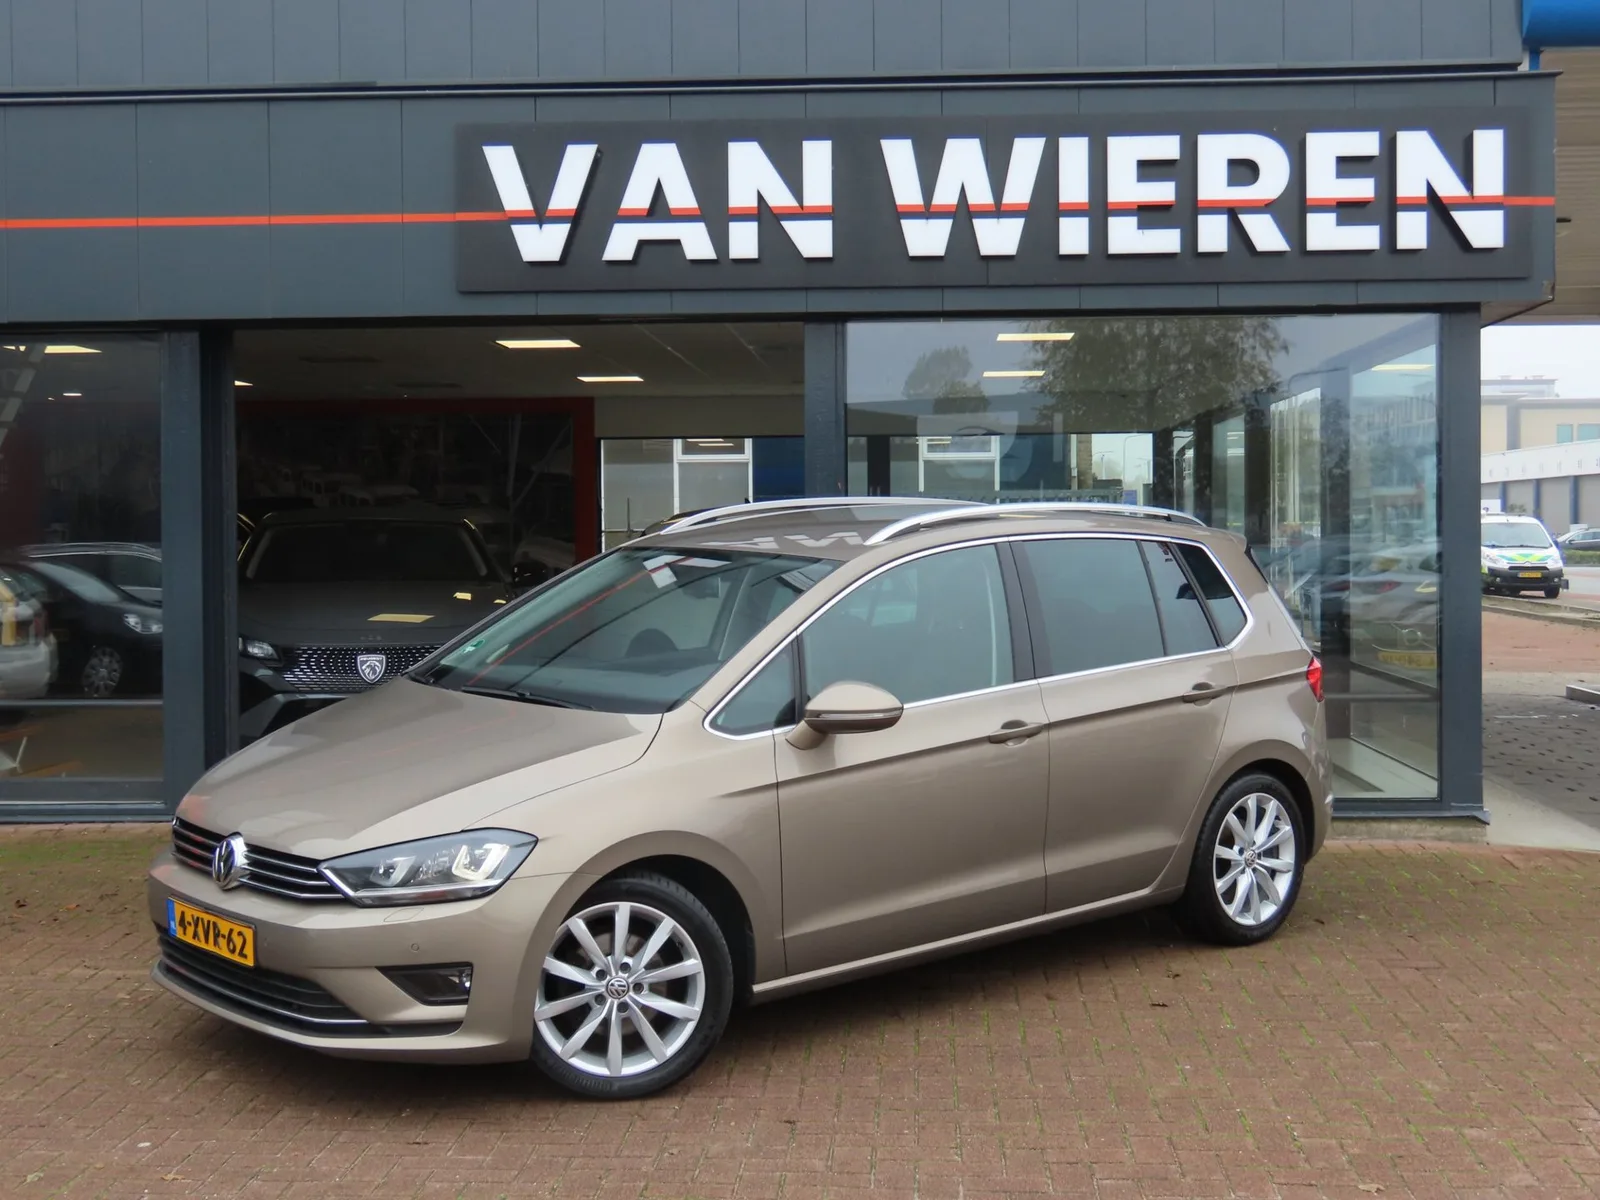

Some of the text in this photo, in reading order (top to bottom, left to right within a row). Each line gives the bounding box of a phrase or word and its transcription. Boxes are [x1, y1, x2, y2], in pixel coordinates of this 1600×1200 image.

[482, 128, 1504, 262] VAN WIEREN
[178, 910, 248, 960] 4-XVR-62
